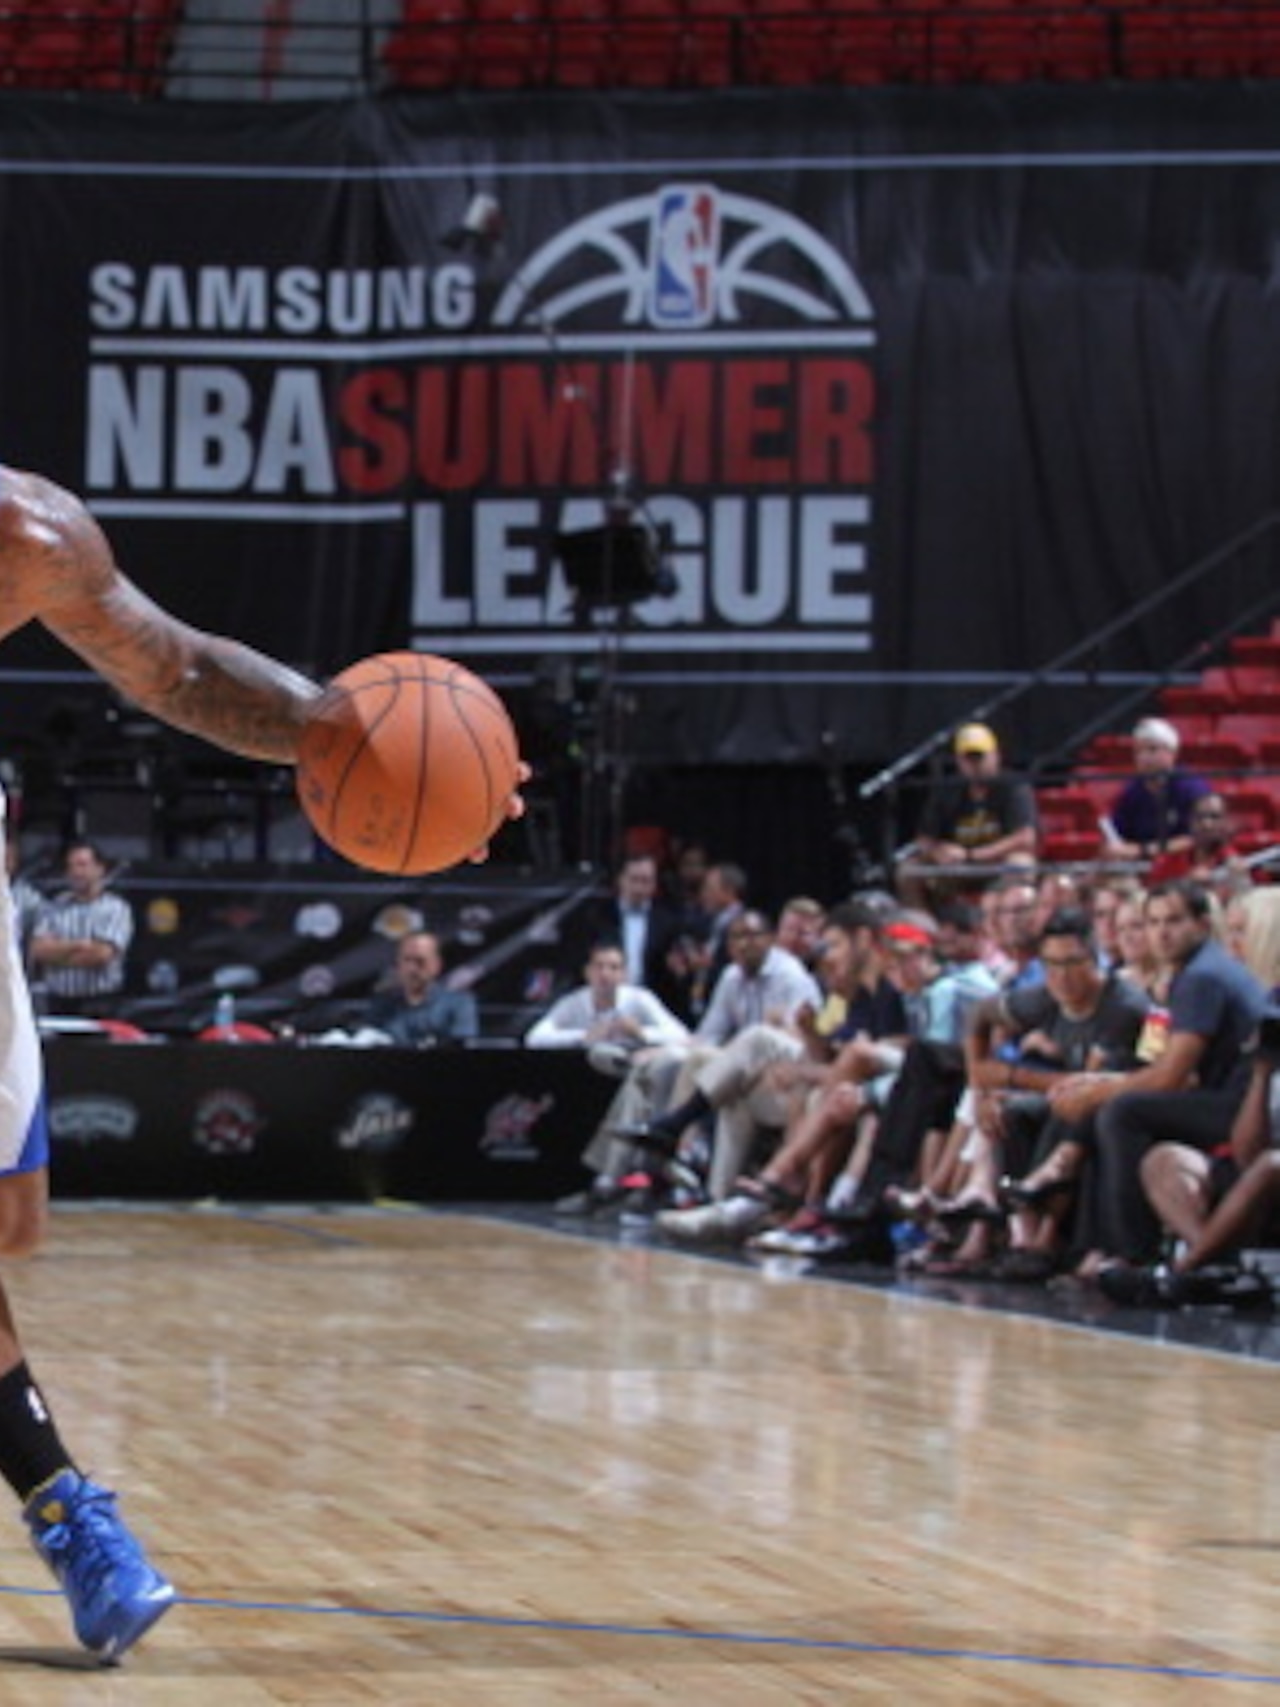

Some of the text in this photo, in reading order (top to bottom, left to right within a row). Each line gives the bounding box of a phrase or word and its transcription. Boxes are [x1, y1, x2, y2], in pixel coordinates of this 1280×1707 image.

[89, 261, 476, 335] SAMSUNG
[85, 359, 877, 495] NBA SUMMER
